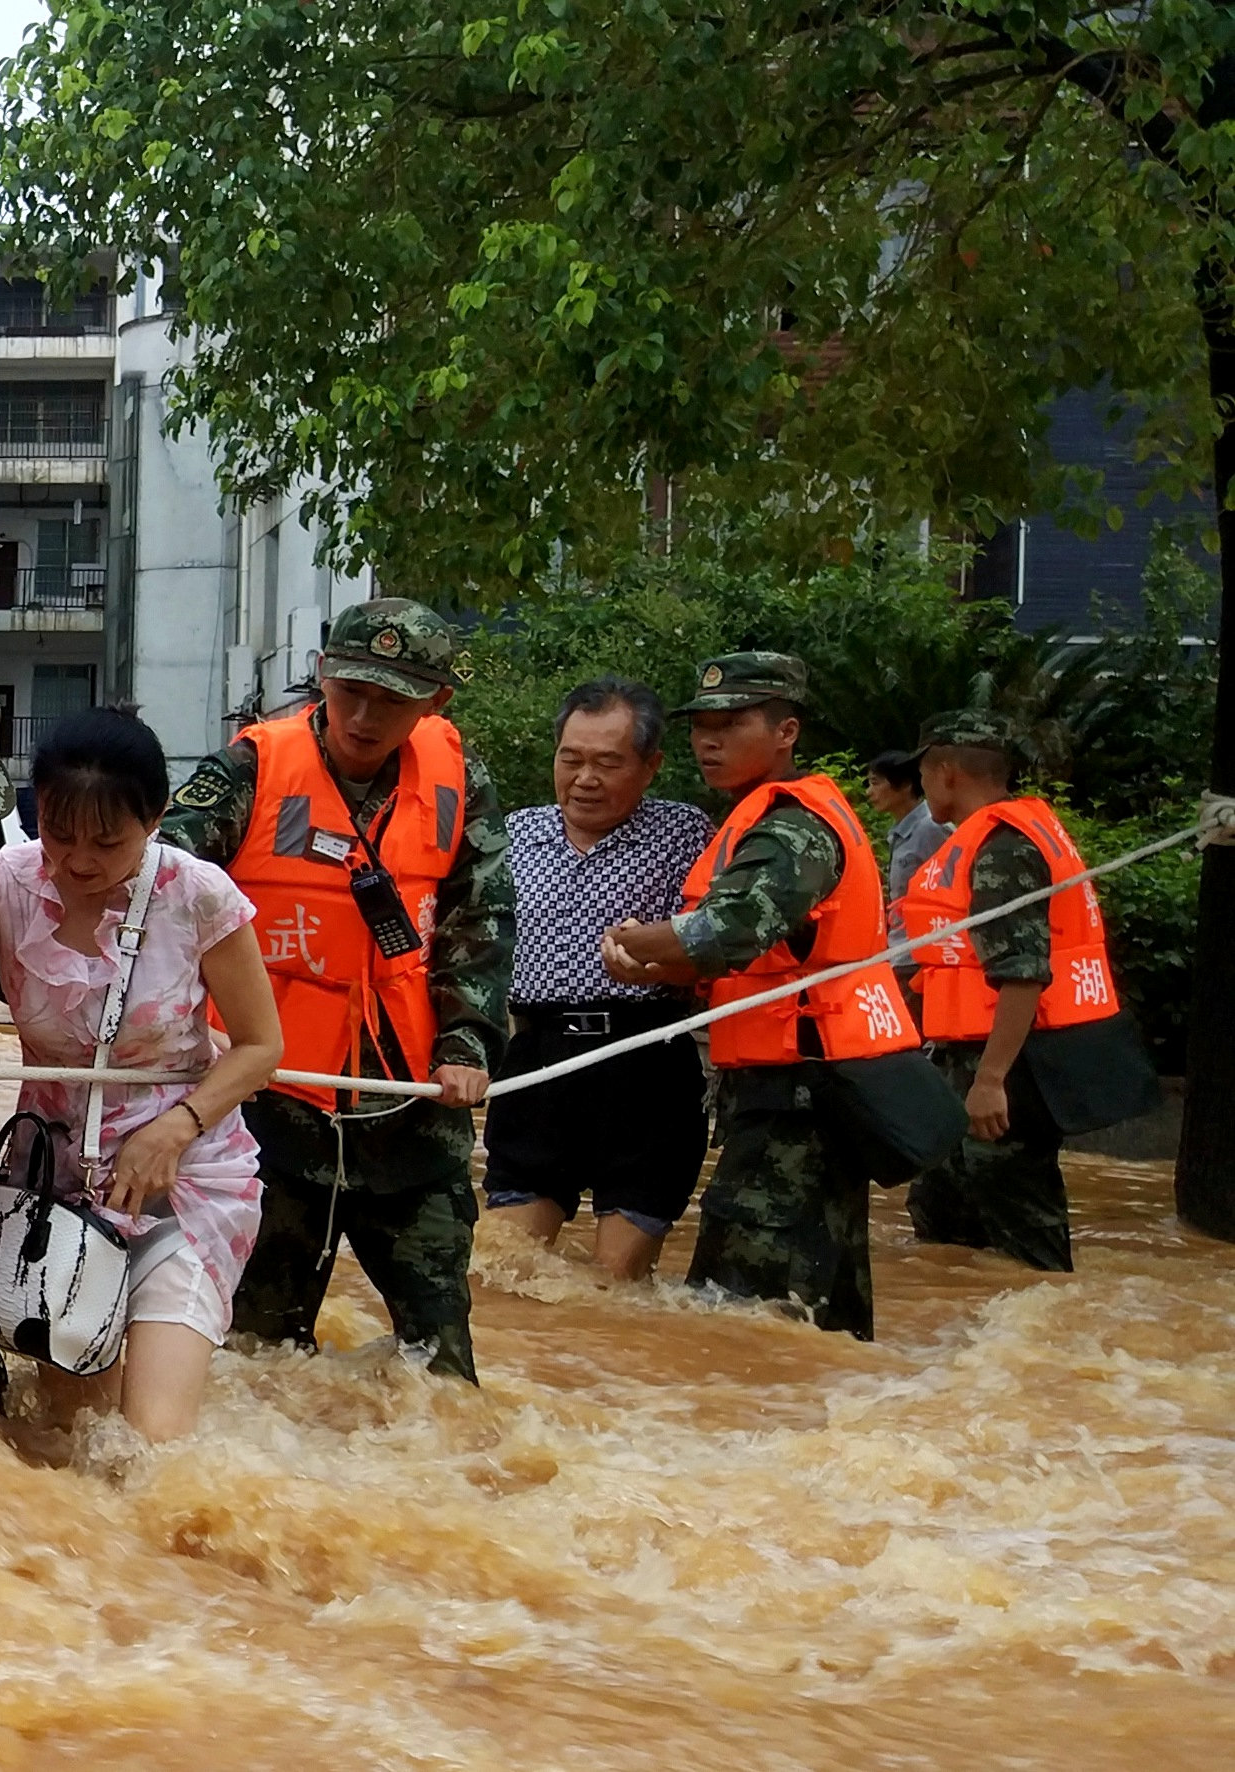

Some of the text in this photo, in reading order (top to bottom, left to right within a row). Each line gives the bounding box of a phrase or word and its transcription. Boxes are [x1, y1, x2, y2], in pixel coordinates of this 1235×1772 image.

[920, 859, 942, 890] 北
[265, 903, 325, 975] 武
[1070, 957, 1109, 1006] 湖
[855, 983, 903, 1040] 湖
